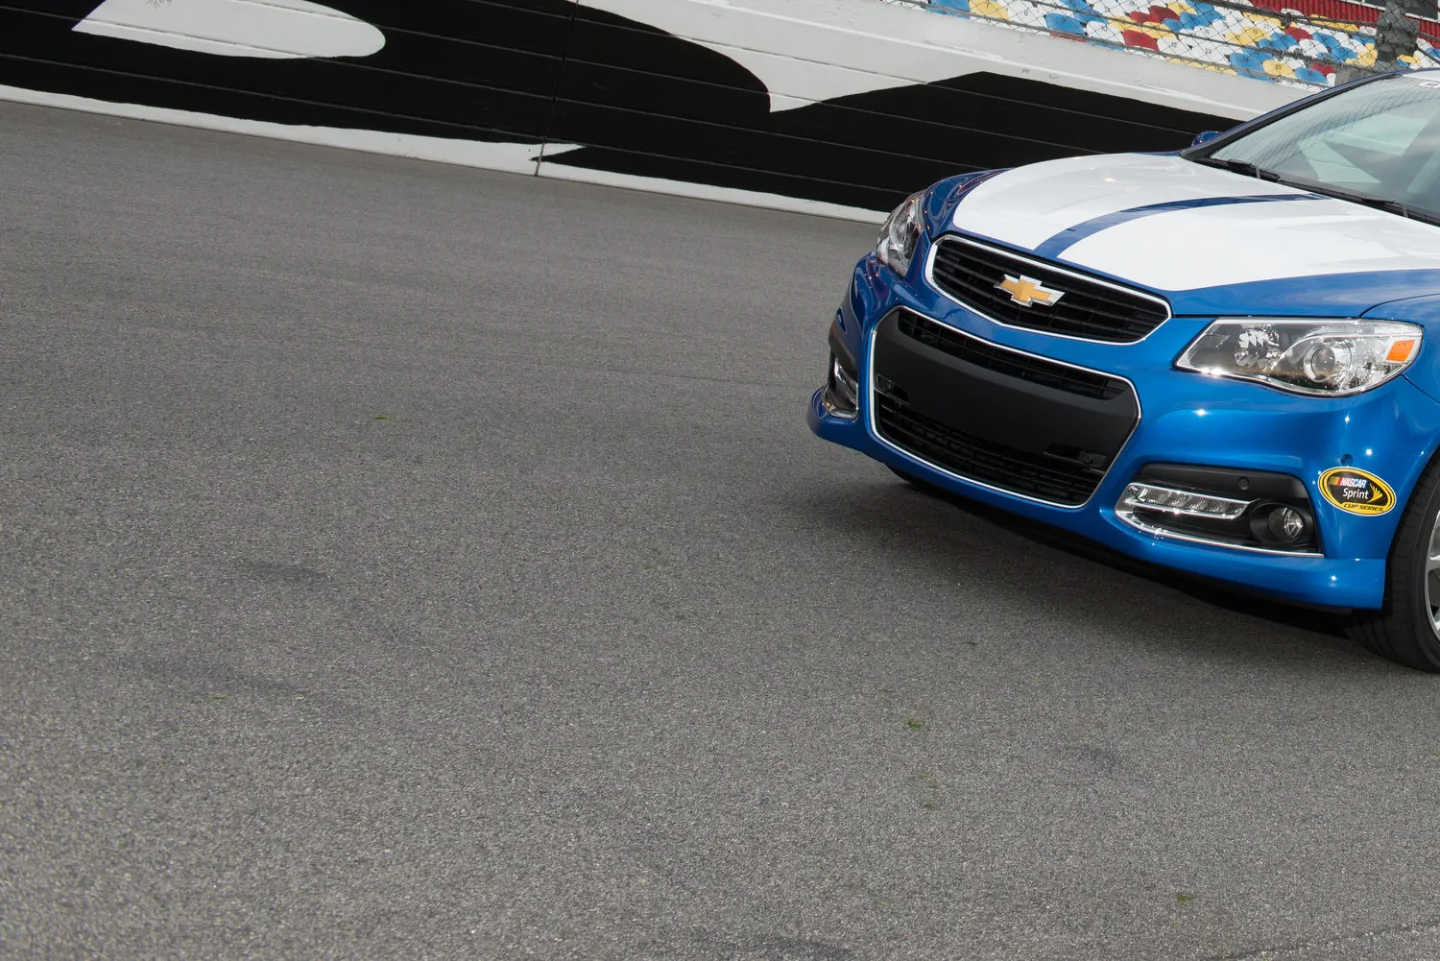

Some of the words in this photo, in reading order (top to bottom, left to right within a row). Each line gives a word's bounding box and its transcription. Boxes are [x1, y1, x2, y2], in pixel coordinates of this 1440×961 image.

[1341, 477, 1367, 488] NASCAR
[1342, 487, 1369, 499] Sprint
[1359, 504, 1384, 512] SERIES
